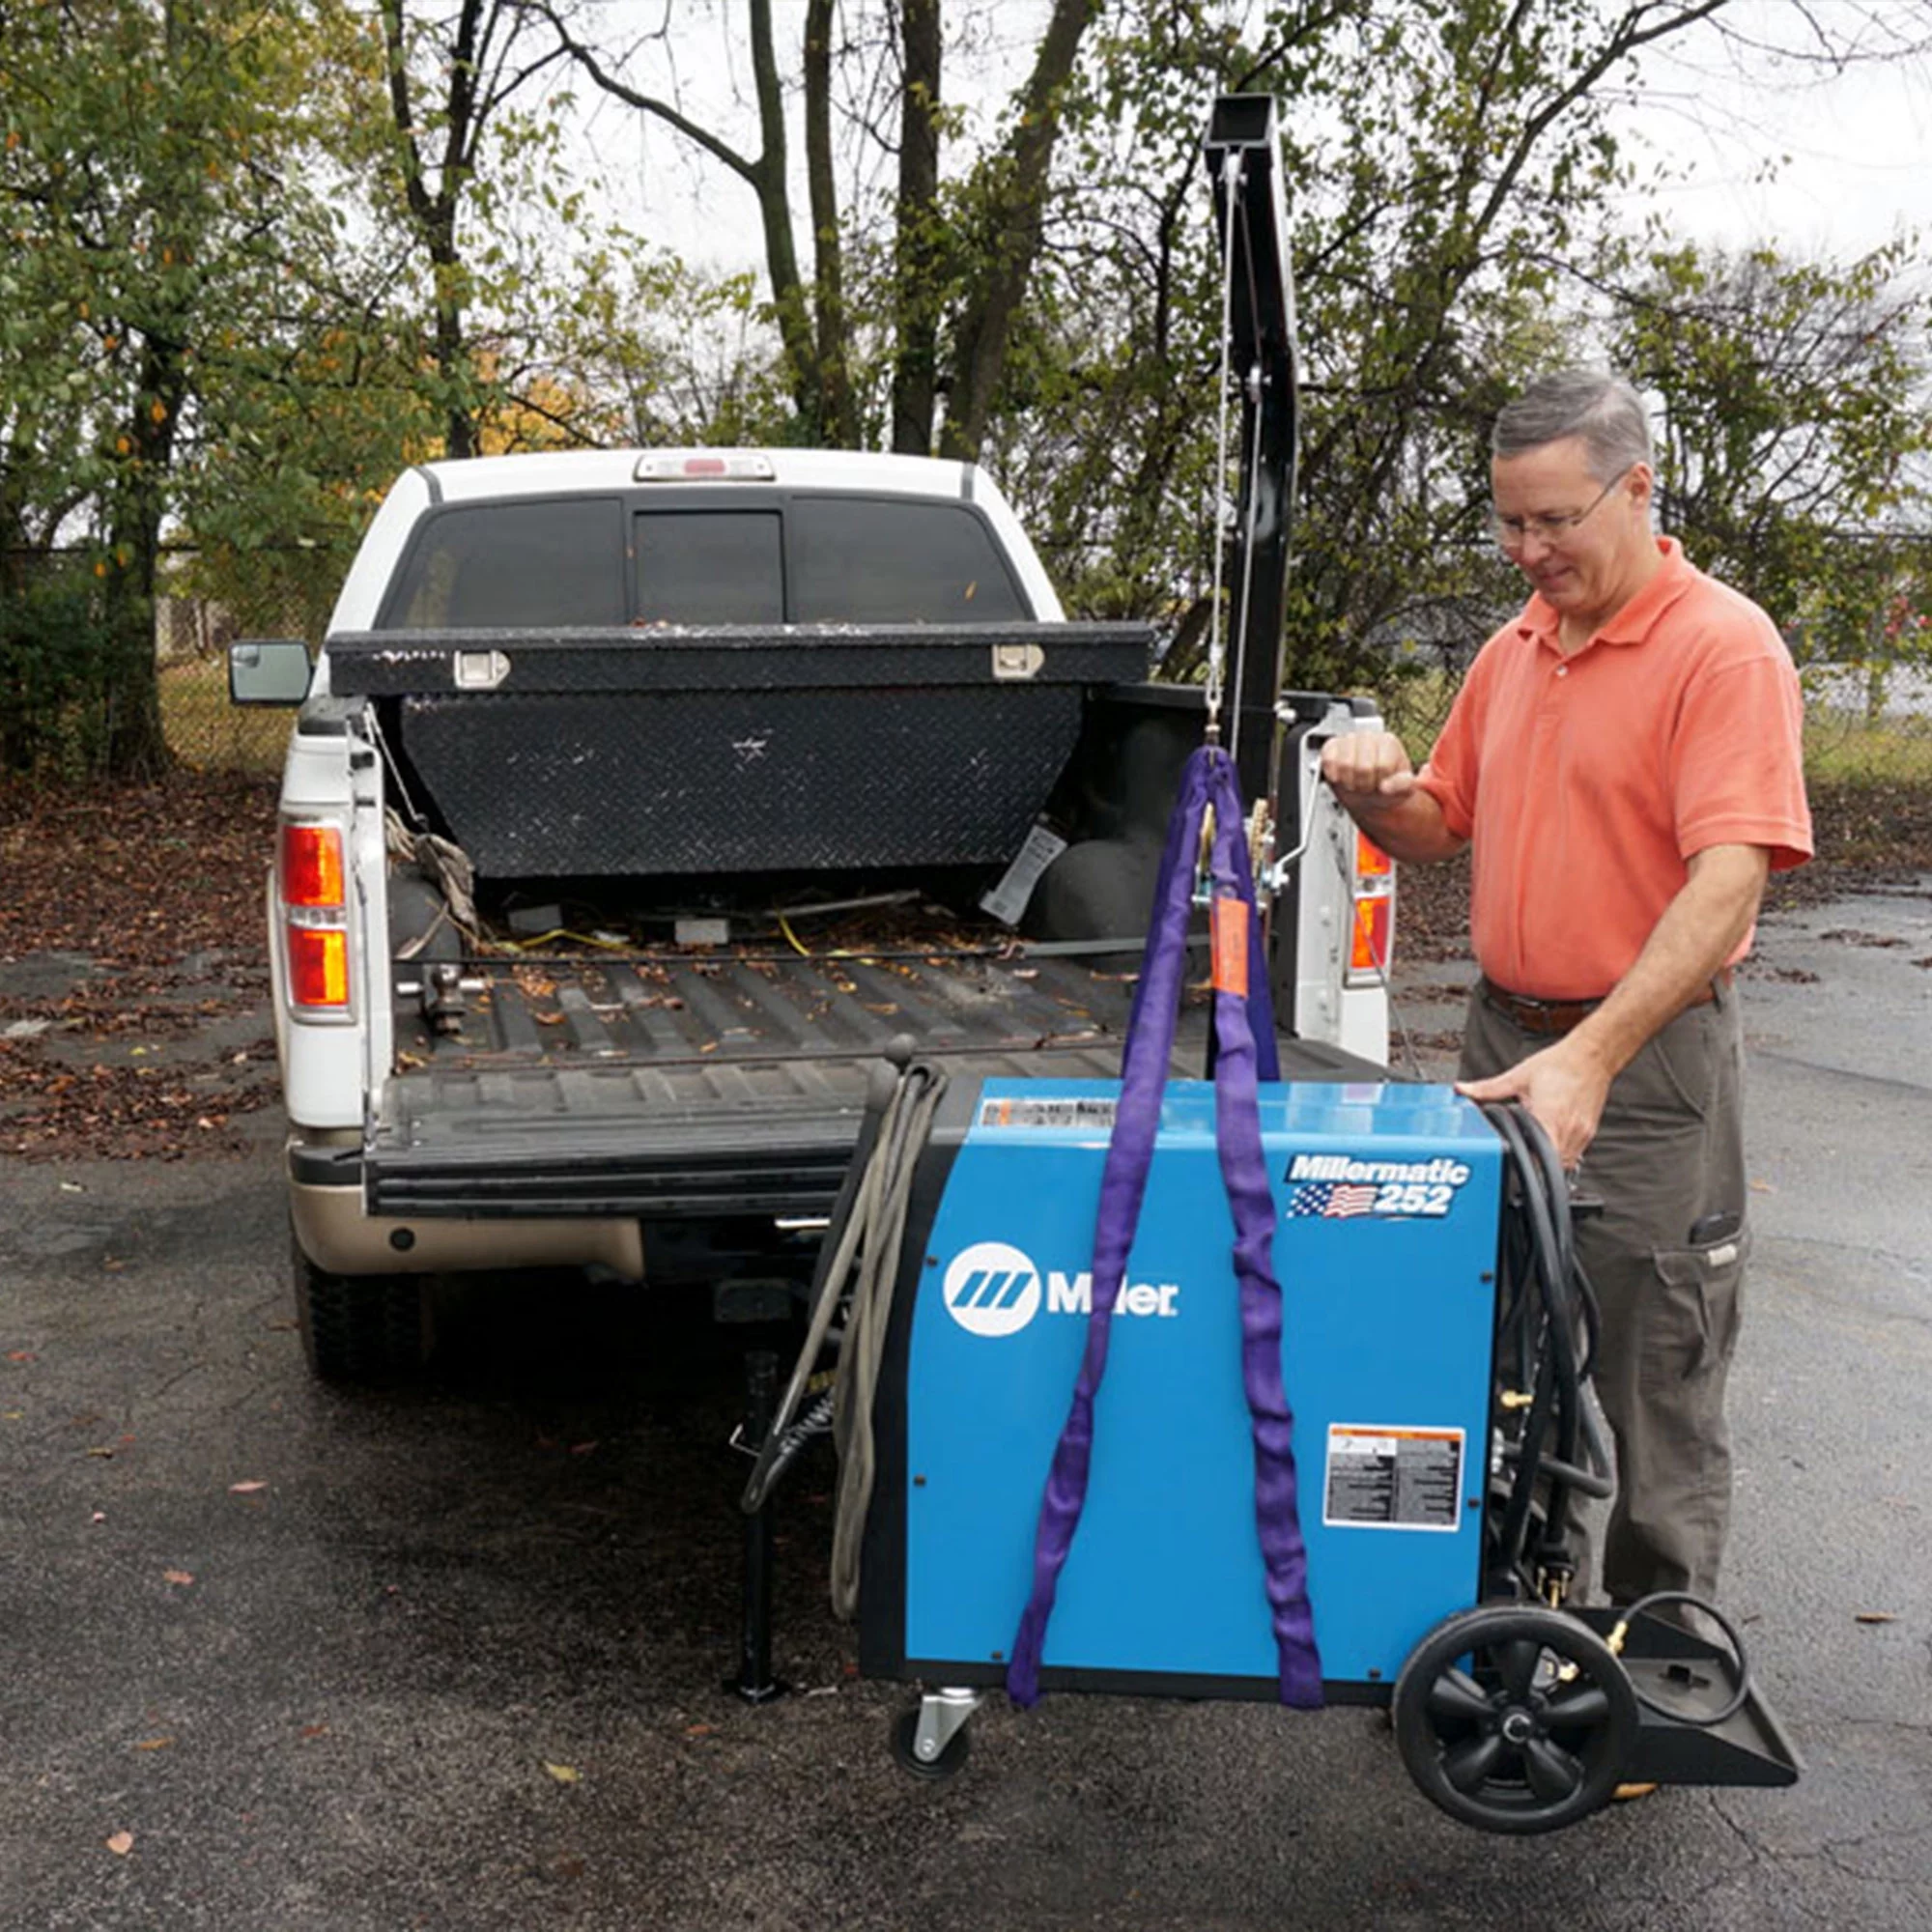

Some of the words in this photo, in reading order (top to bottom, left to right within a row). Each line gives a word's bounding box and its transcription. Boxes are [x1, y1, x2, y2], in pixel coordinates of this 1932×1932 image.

[1288, 1154, 1471, 1186] Millermatic
[1373, 1183, 1454, 1215] 252
[1046, 1270, 1179, 1317] Mler
